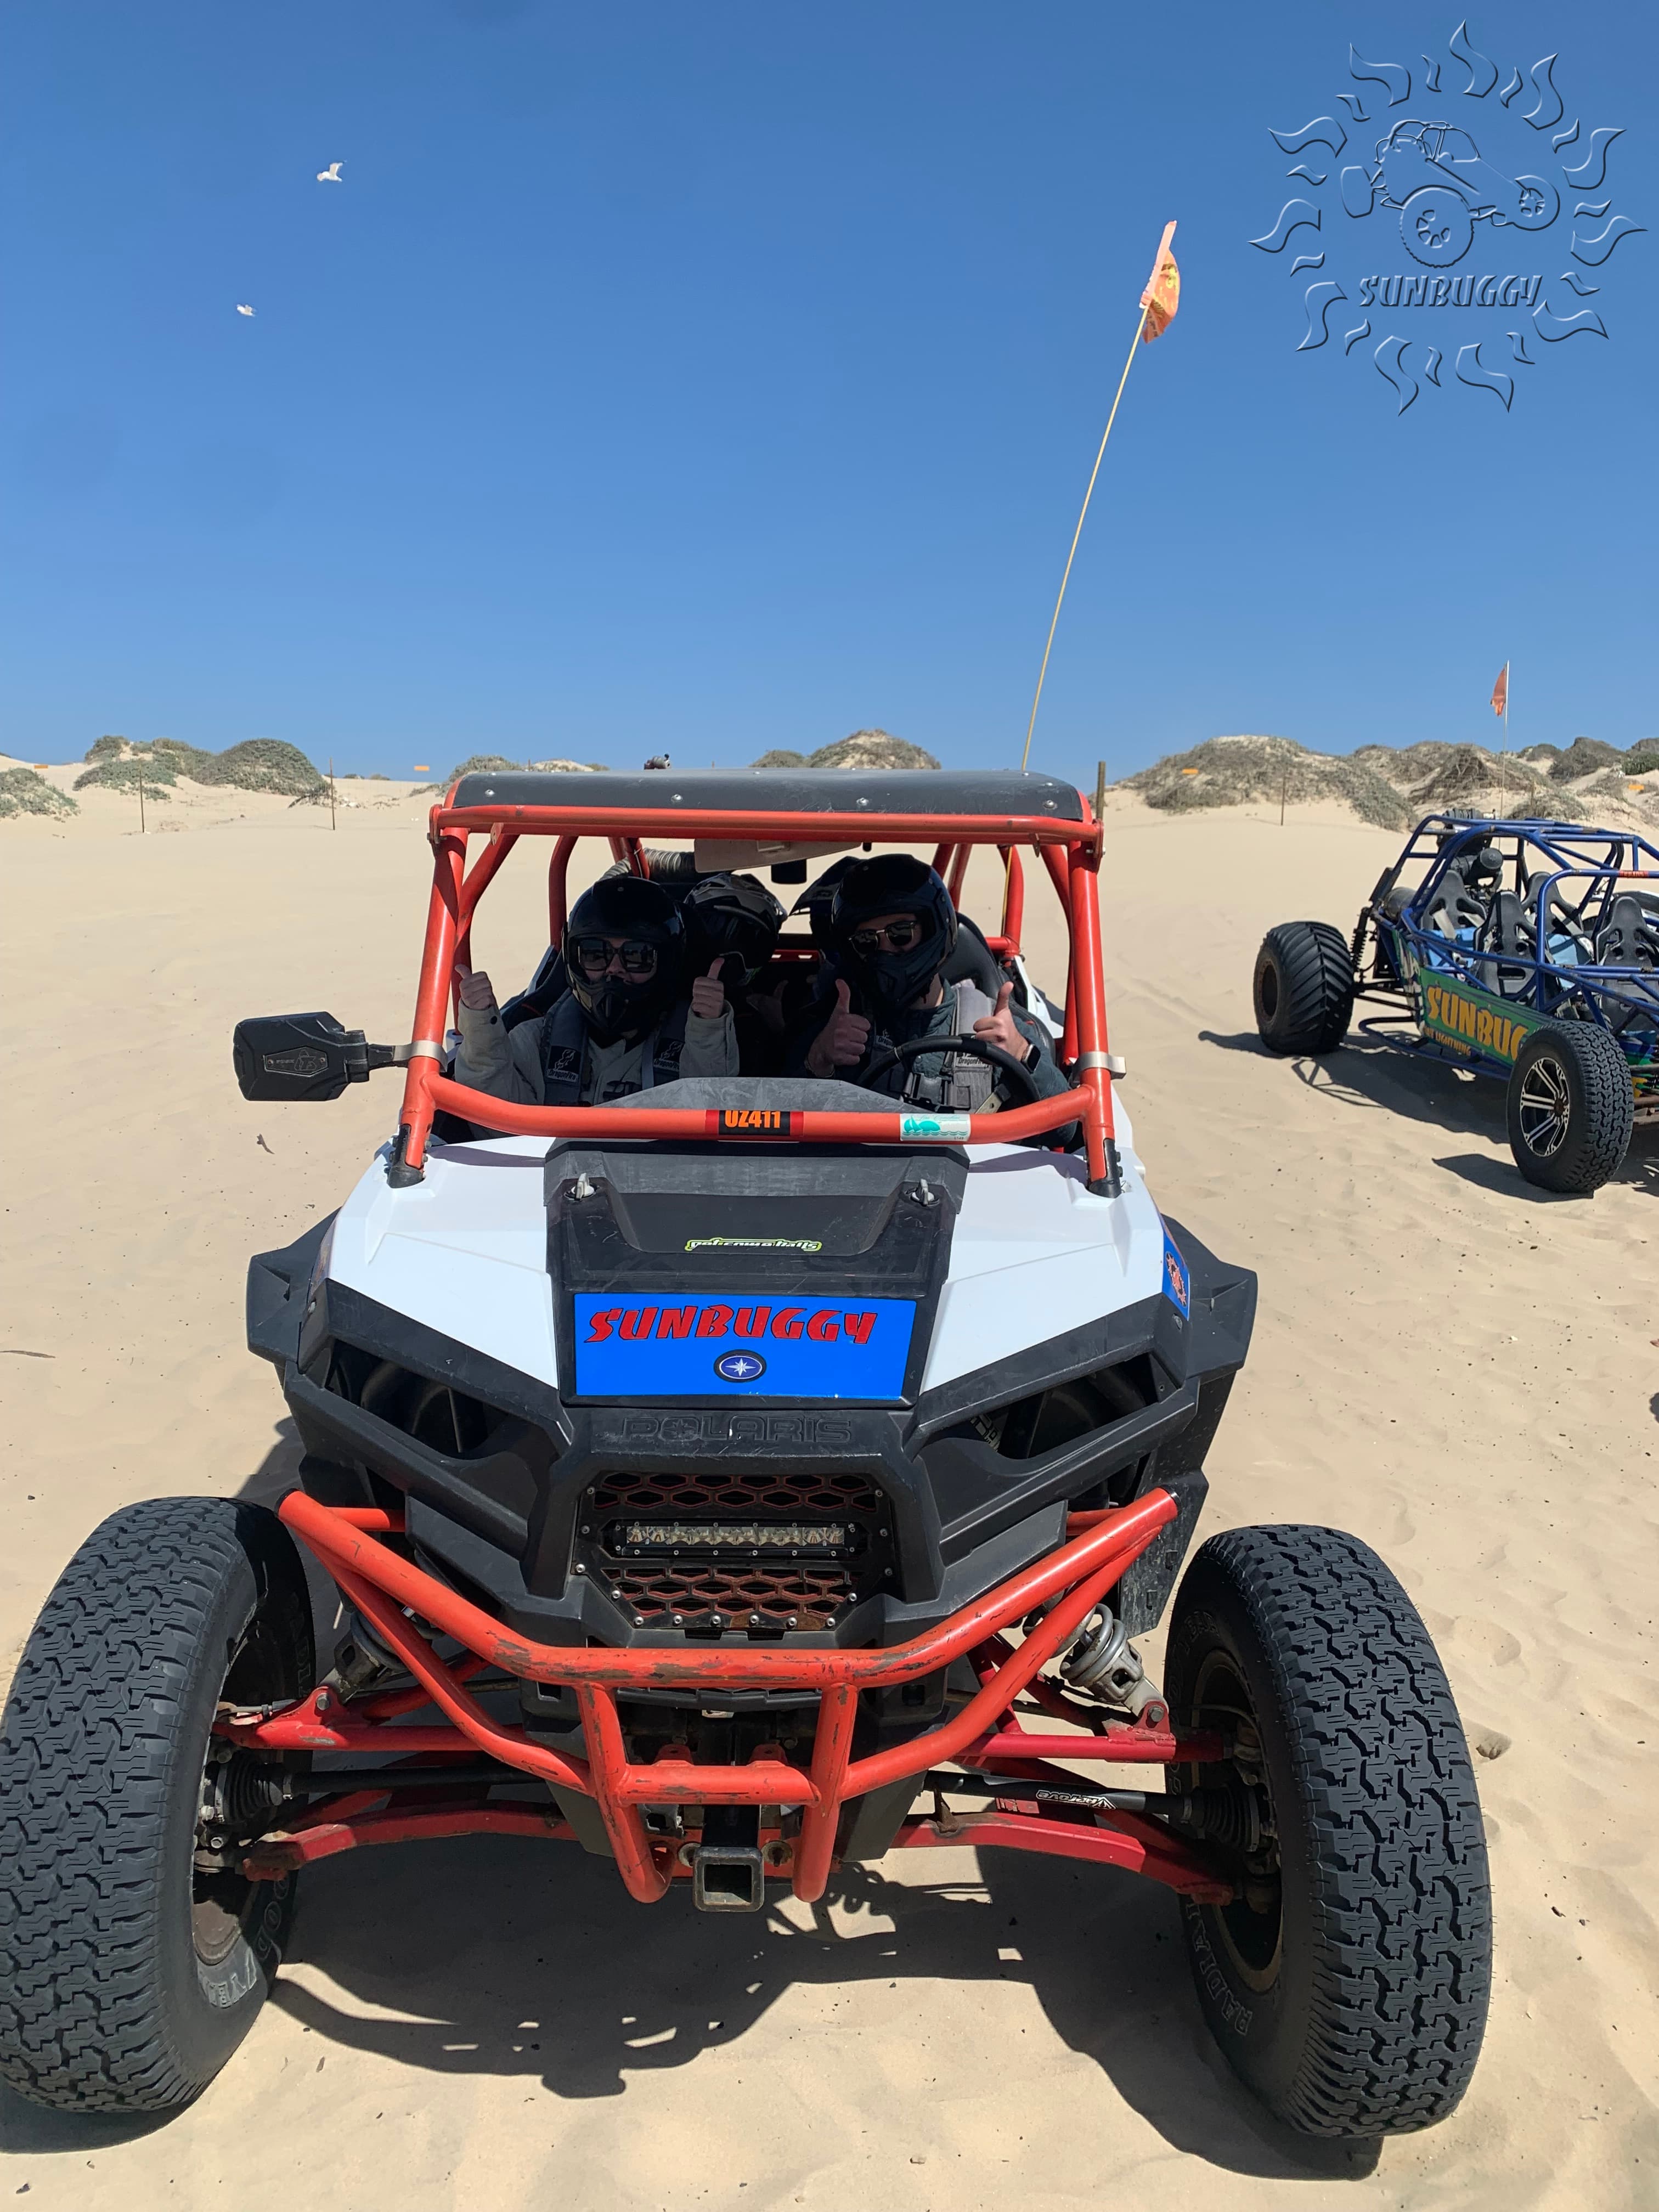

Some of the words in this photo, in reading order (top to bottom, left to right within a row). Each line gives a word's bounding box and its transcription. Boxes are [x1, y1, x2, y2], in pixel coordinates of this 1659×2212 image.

[724, 1110, 781, 1128] UZ411
[584, 1304, 878, 1344] SUNBUGGY
[623, 1415, 851, 1443] POLARIS
